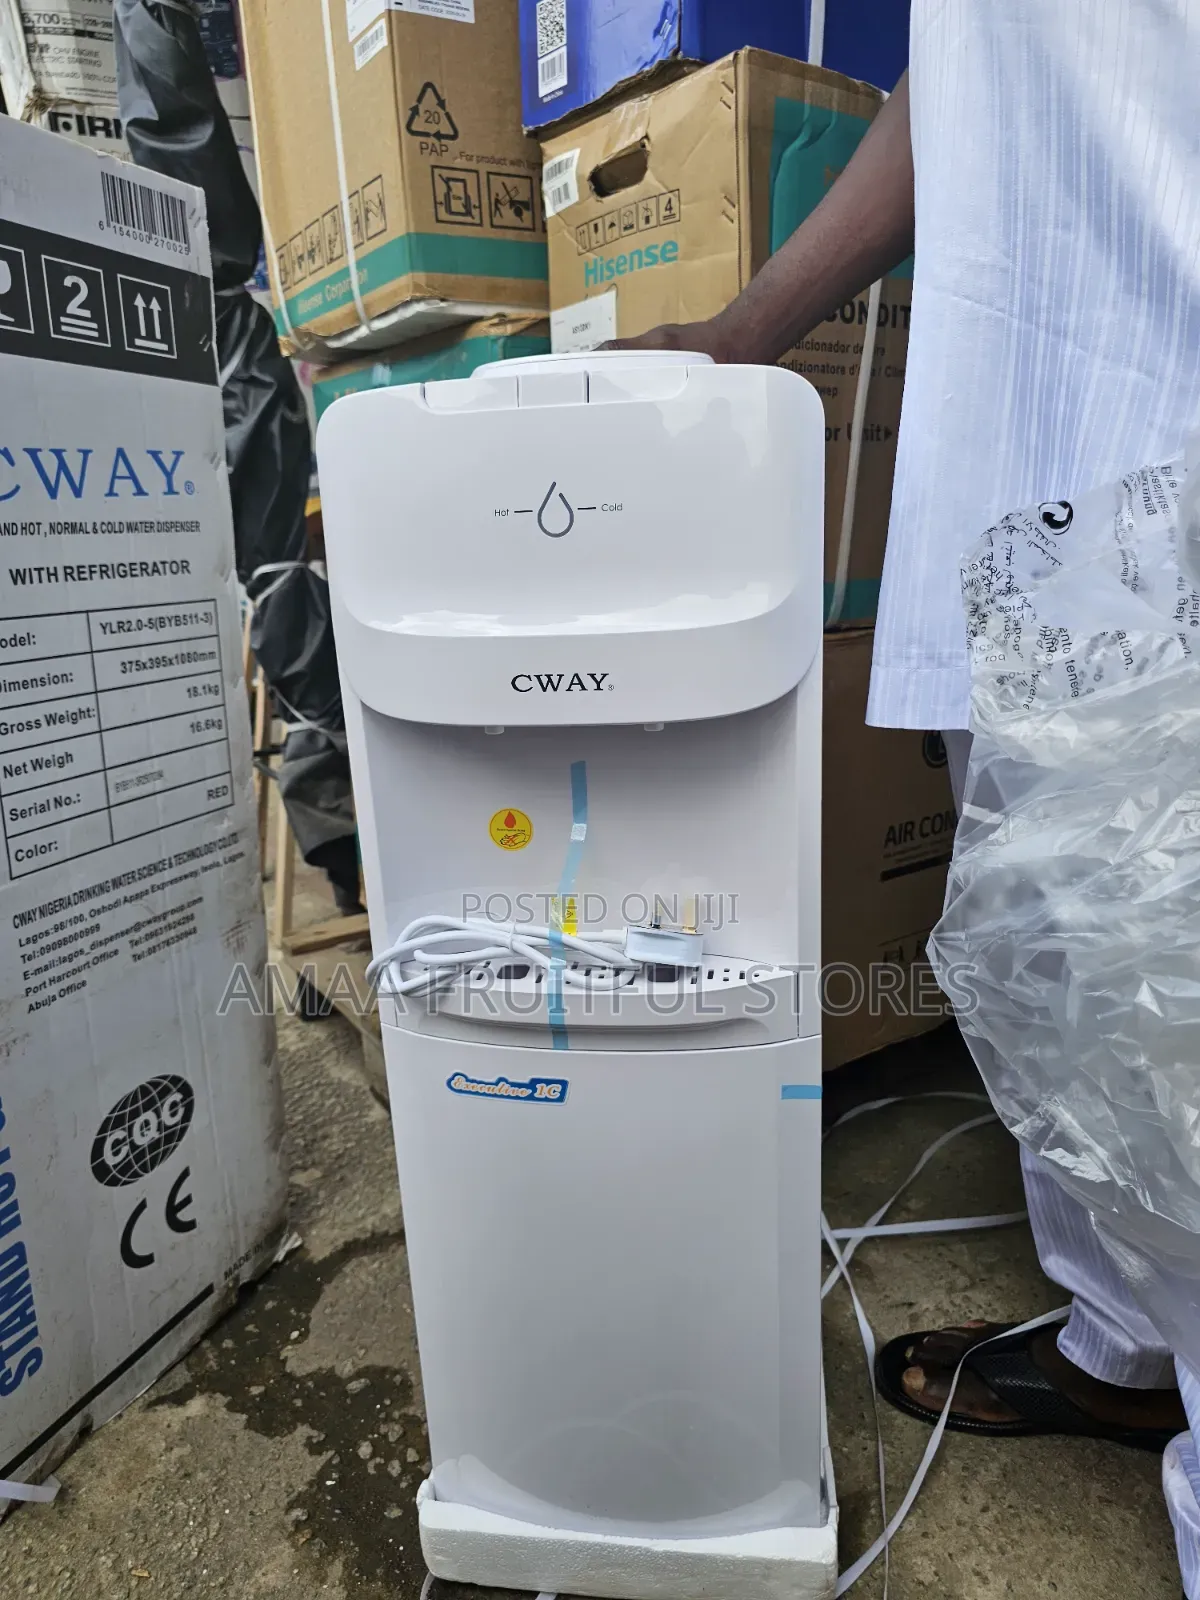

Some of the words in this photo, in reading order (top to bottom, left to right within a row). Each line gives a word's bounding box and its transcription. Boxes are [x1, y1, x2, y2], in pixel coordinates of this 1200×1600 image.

[424, 110, 441, 125] 20
[419, 141, 449, 157] PAP
[459, 151, 475, 162] For
[475, 153, 508, 167] product
[664, 197, 674, 214] 4
[98, 220, 105, 231] 6
[112, 225, 151, 245] 154000
[584, 239, 679, 288] Hisense
[63, 275, 91, 318] 2
[494, 508, 509, 517] Hot
[601, 503, 623, 512] Cold
[49, 521, 90, 536] NORMAL
[92, 521, 99, 534] &
[100, 520, 125, 534] COLD
[126, 520, 156, 534] WATER
[156, 520, 201, 533] DISPENSER
[9, 566, 60, 586] WITH
[63, 559, 192, 583] REFRIGERATOR
[119, 649, 217, 674] 375x395x1080mm
[0, 713, 42, 736] Gross
[44, 706, 96, 729] Weight:
[186, 682, 220, 699] 18.1kg
[2, 762, 28, 779] Net
[30, 750, 74, 772] Weigh
[9, 799, 51, 822] Serial
[53, 791, 82, 809] No.:
[14, 839, 60, 863] Color:
[206, 784, 229, 801] RED
[884, 820, 915, 849] AIR
[13, 908, 38, 930] CWAY
[39, 896, 74, 921] NIGERIA
[73, 880, 111, 907] DRINKING
[111, 870, 137, 892] WATER
[137, 858, 168, 882] SCIENCE
[89, 898, 122, 919] Oshodi
[25, 980, 47, 998] Port
[49, 960, 91, 987] Harcourt
[92, 948, 119, 968] Office
[27, 994, 57, 1014] Abuja
[58, 978, 88, 1000] Office
[103, 1091, 185, 1166] CQC
[223, 1253, 251, 1281] MADE
